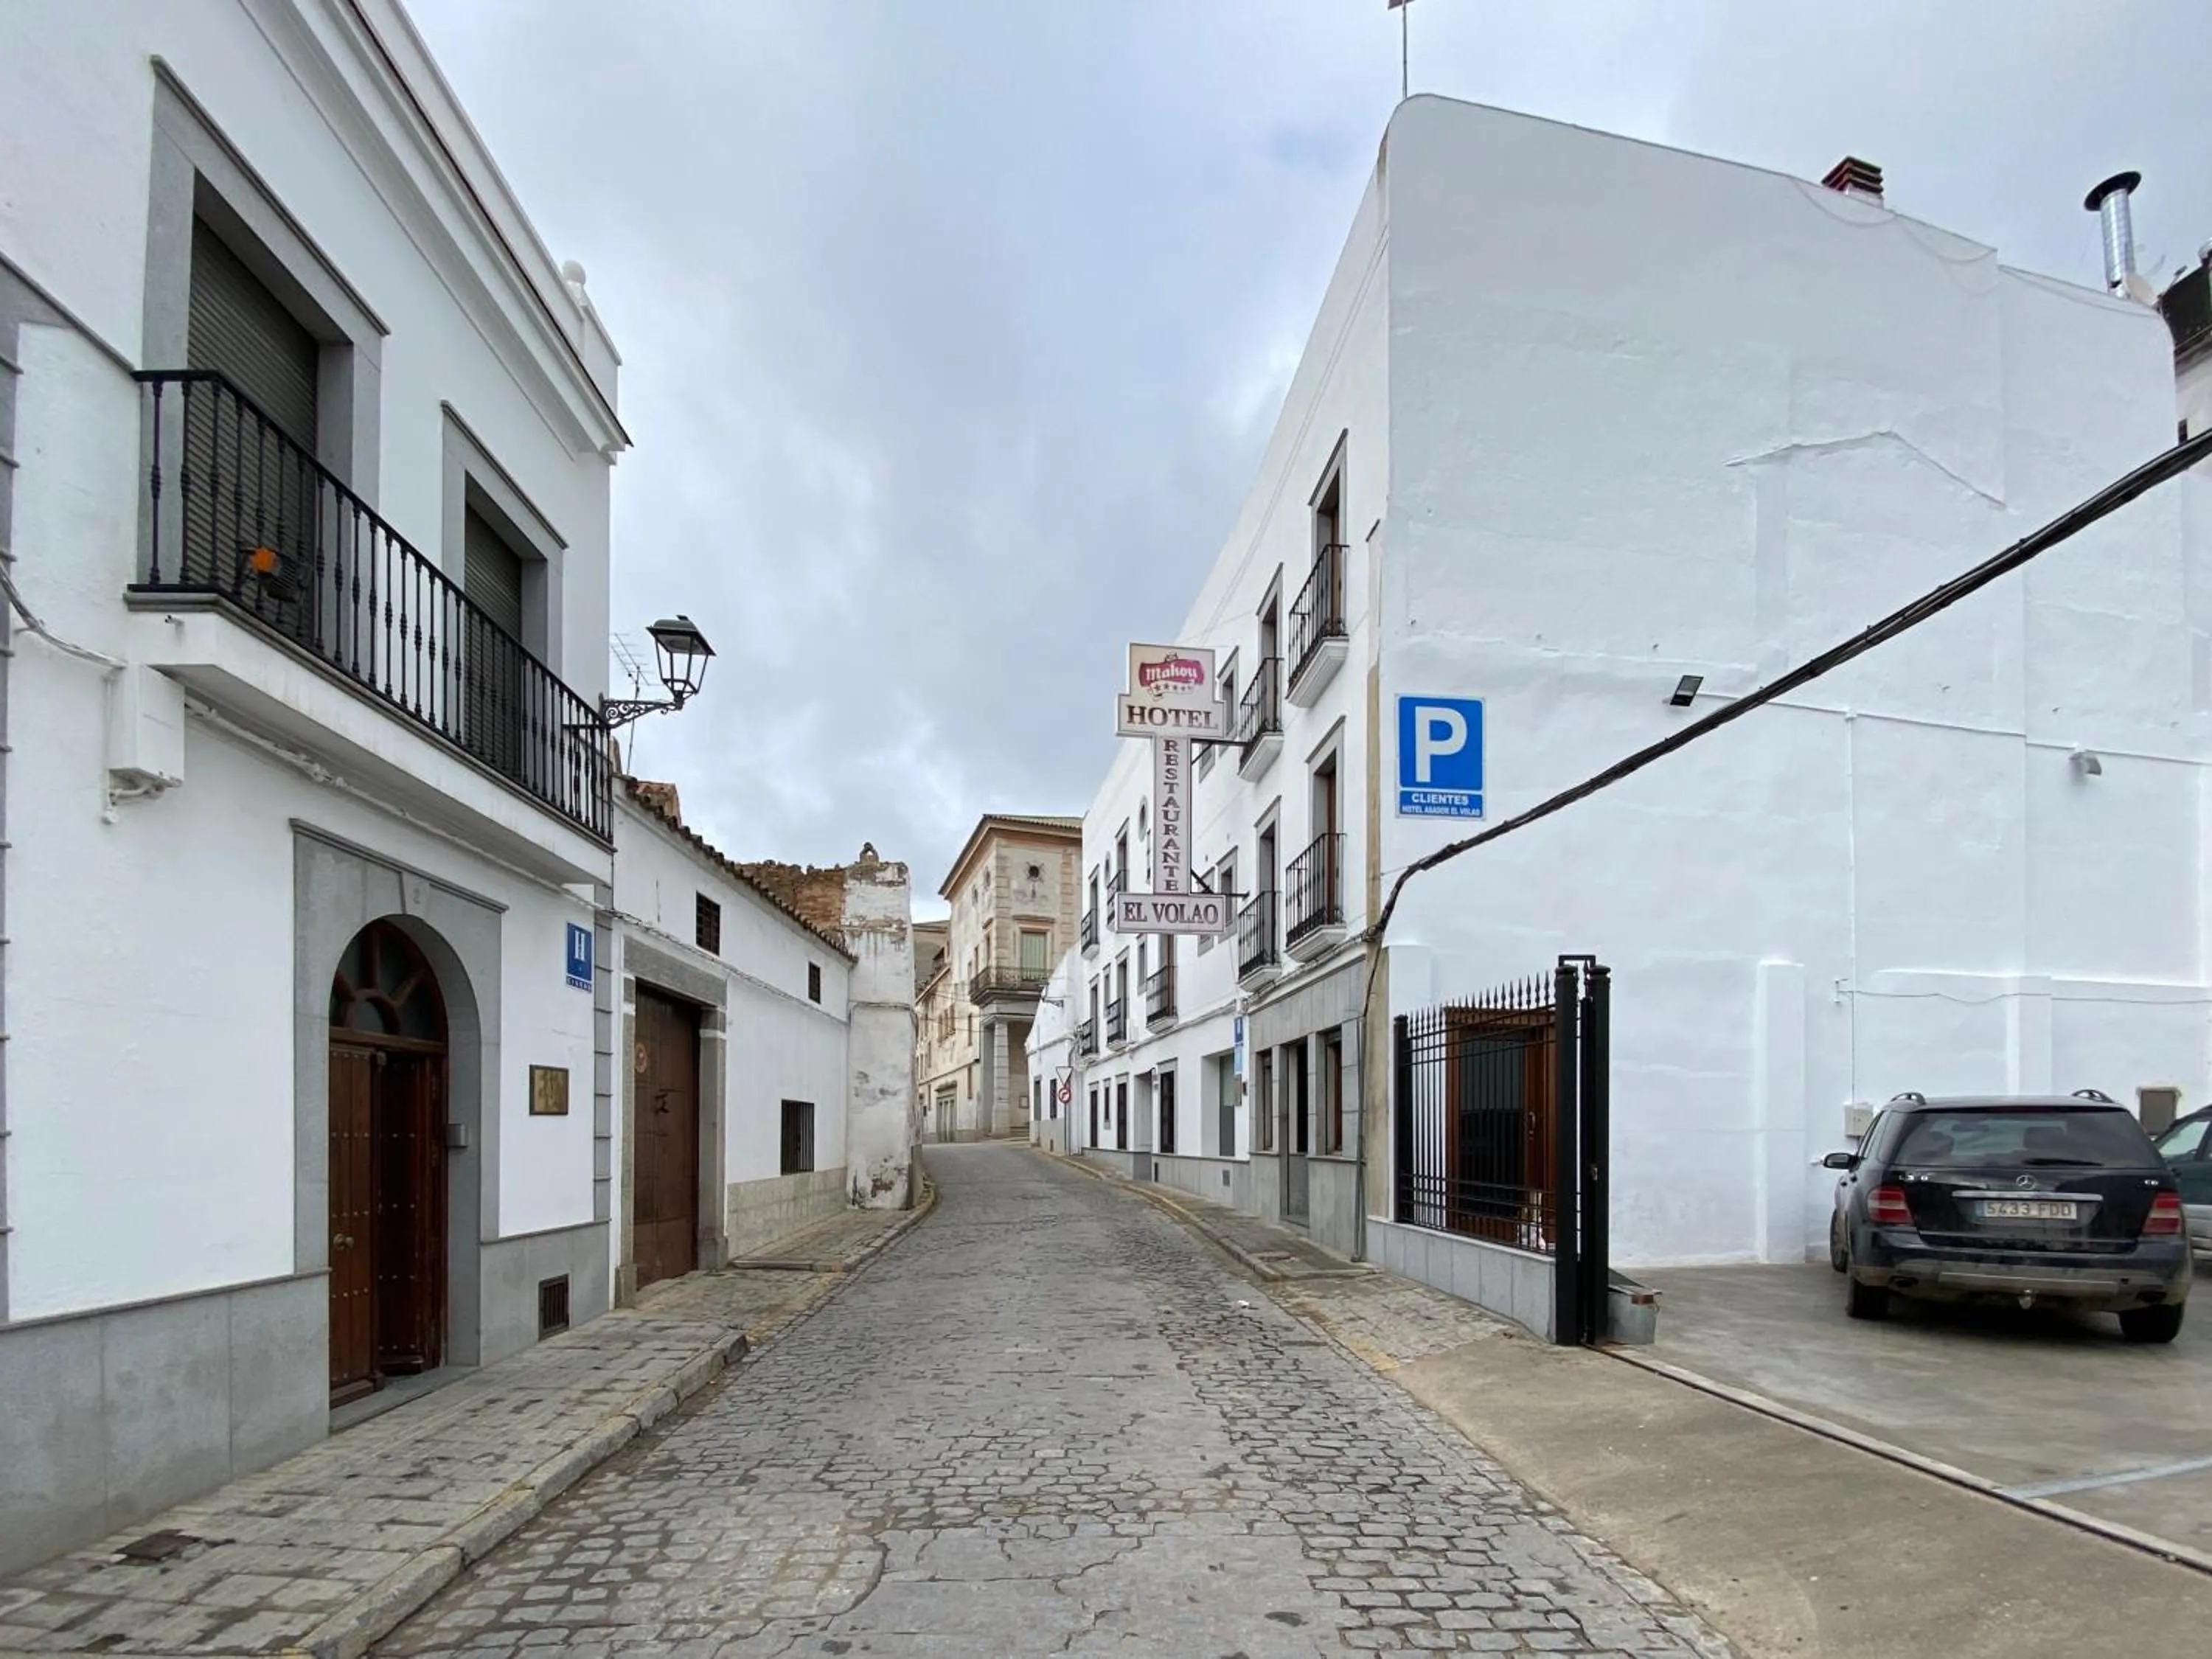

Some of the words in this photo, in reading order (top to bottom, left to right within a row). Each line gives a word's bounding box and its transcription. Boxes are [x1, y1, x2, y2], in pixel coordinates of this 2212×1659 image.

[1127, 705, 1218, 729] HOTEL
[1415, 706, 1467, 782] P
[1411, 792, 1469, 805] CLIENTES
[1162, 740, 1180, 891] RESTAURANTE
[1123, 902, 1148, 922] EL
[1152, 902, 1219, 925] VOLAO
[575, 930, 585, 961] H
